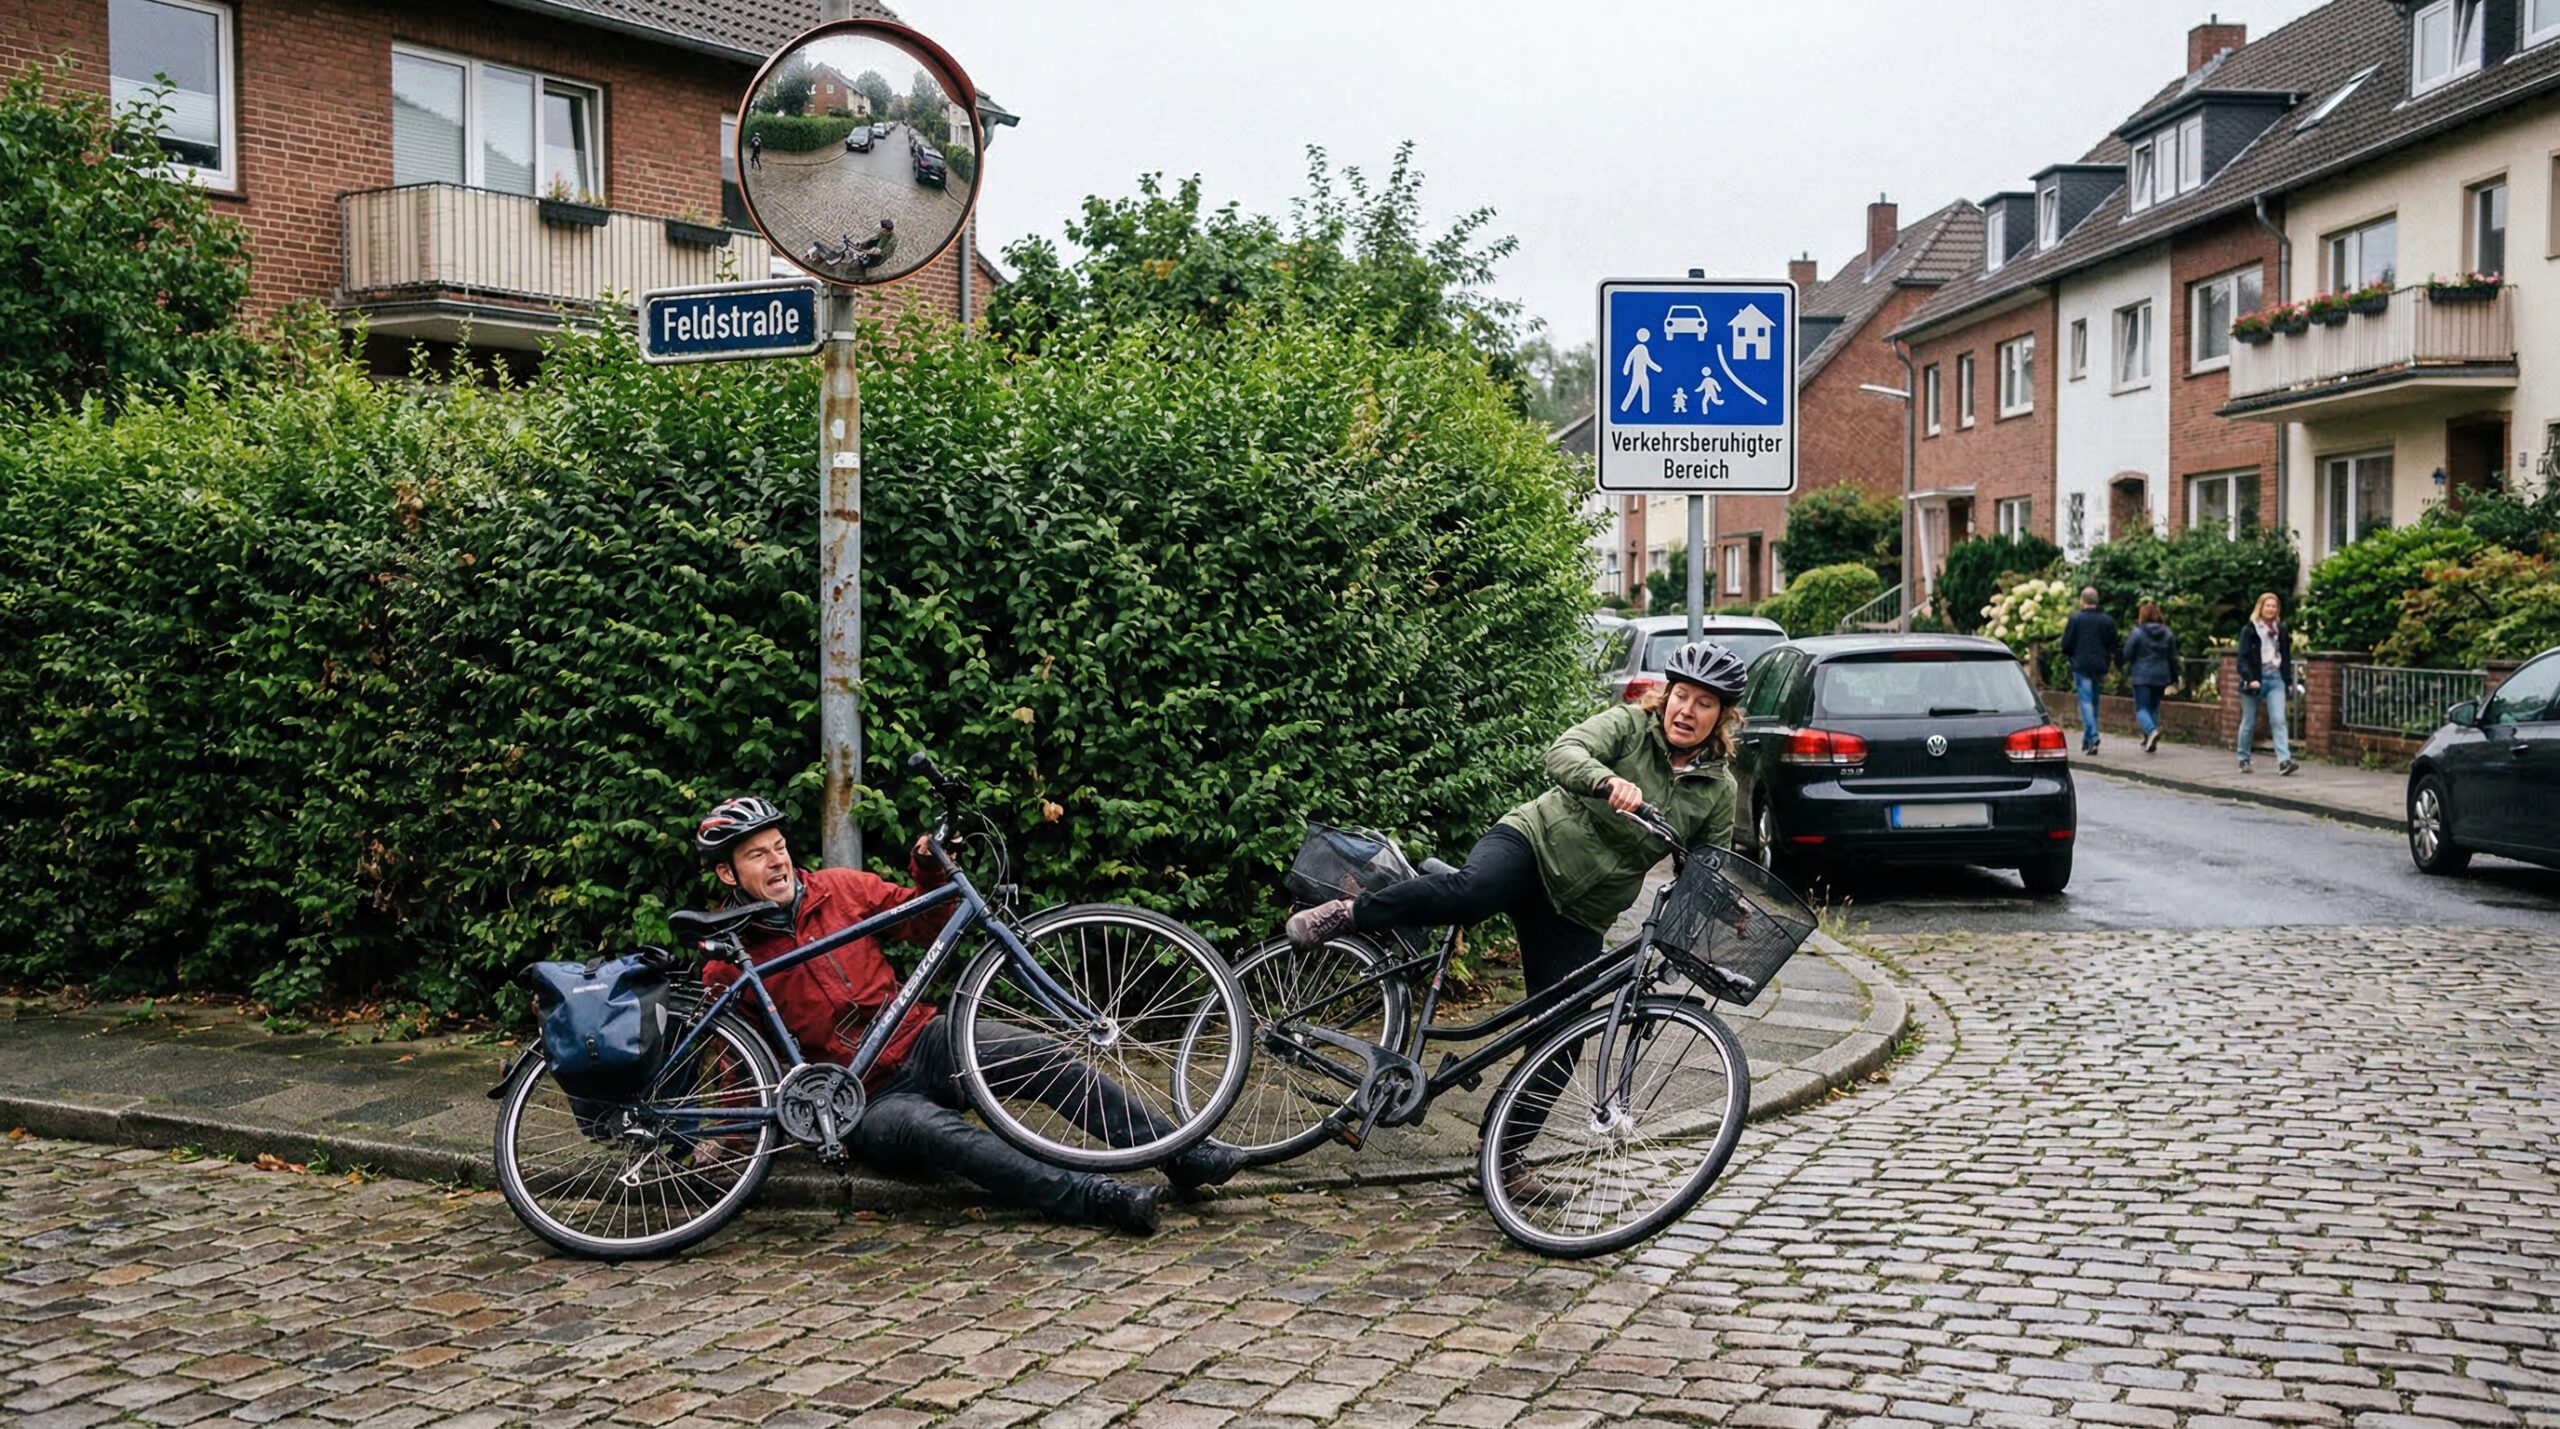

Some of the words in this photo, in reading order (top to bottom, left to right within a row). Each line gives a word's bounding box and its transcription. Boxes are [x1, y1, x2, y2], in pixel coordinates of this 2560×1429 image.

[663, 299, 800, 342] Feldstraße
[1611, 431, 1783, 458] Verkehrsberuhigter
[1663, 458, 1729, 479] Bereich
